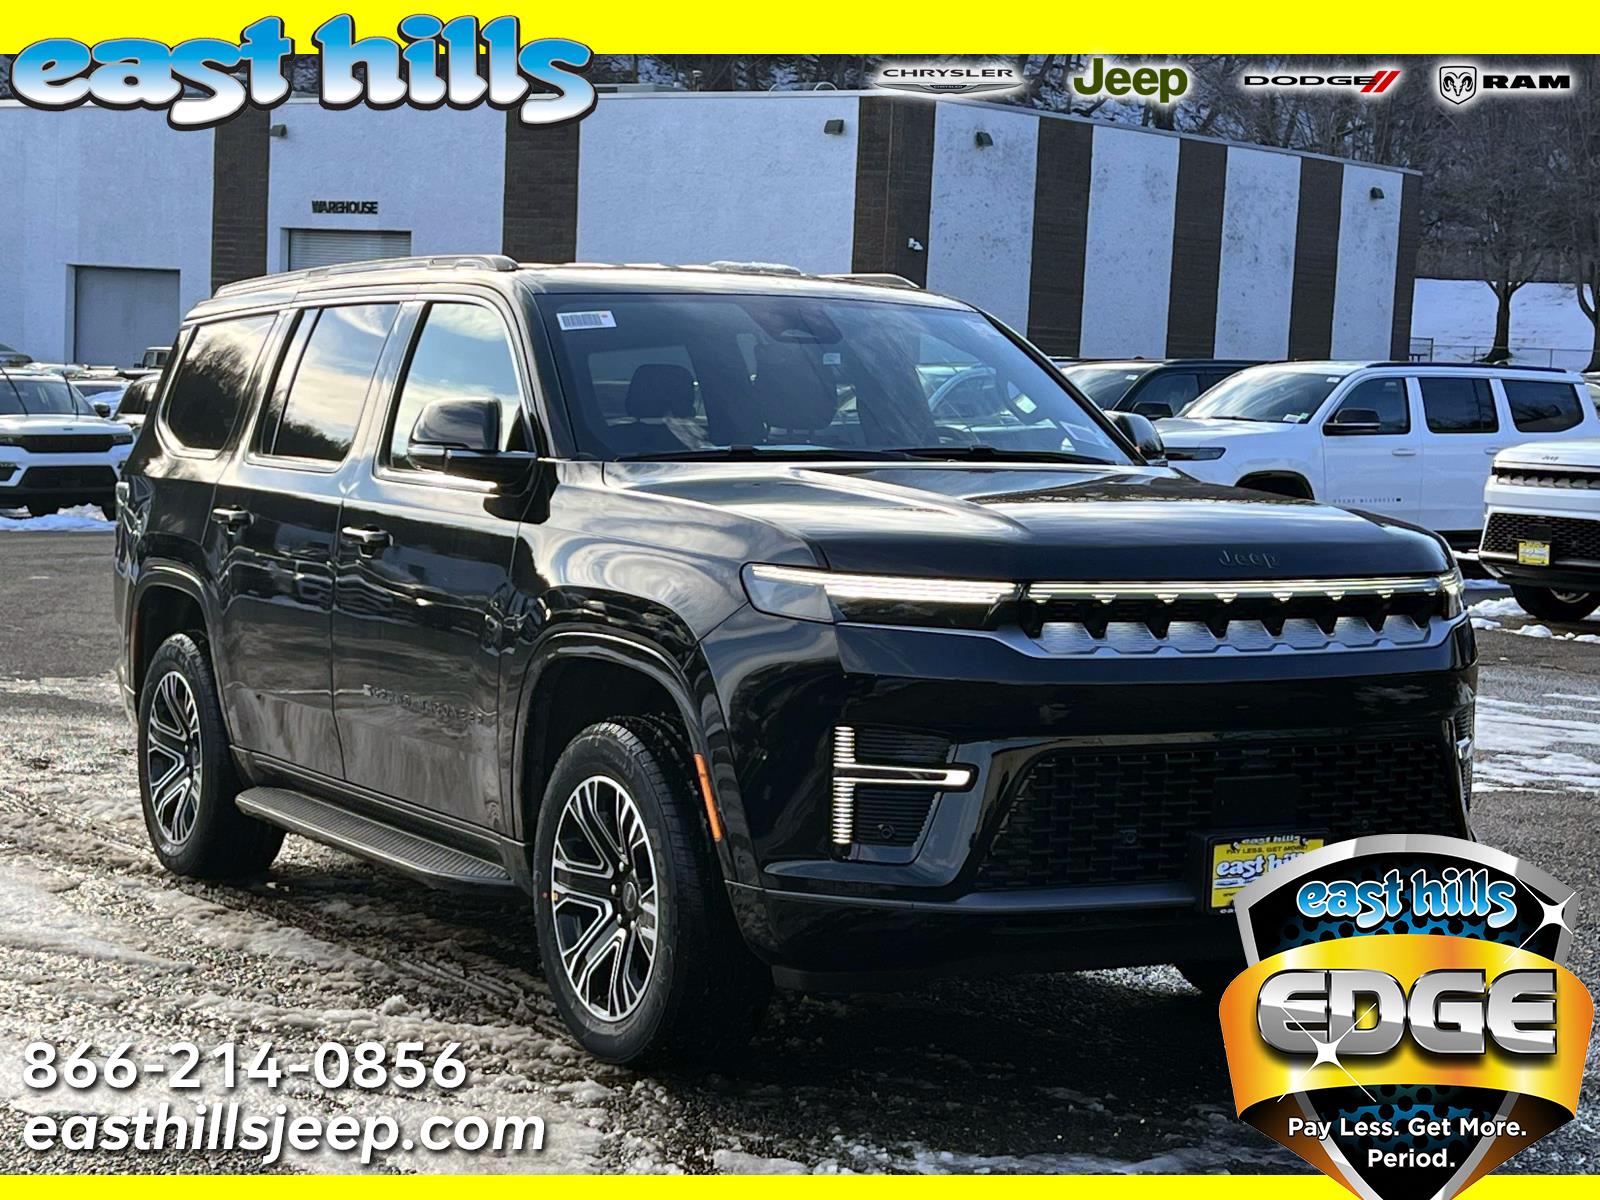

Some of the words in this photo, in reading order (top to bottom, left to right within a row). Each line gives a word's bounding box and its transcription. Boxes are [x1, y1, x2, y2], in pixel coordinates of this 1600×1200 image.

[311, 200, 378, 215] WAREHOUSE
[1218, 549, 1280, 569] Jeep
[1216, 854, 1265, 878] east
